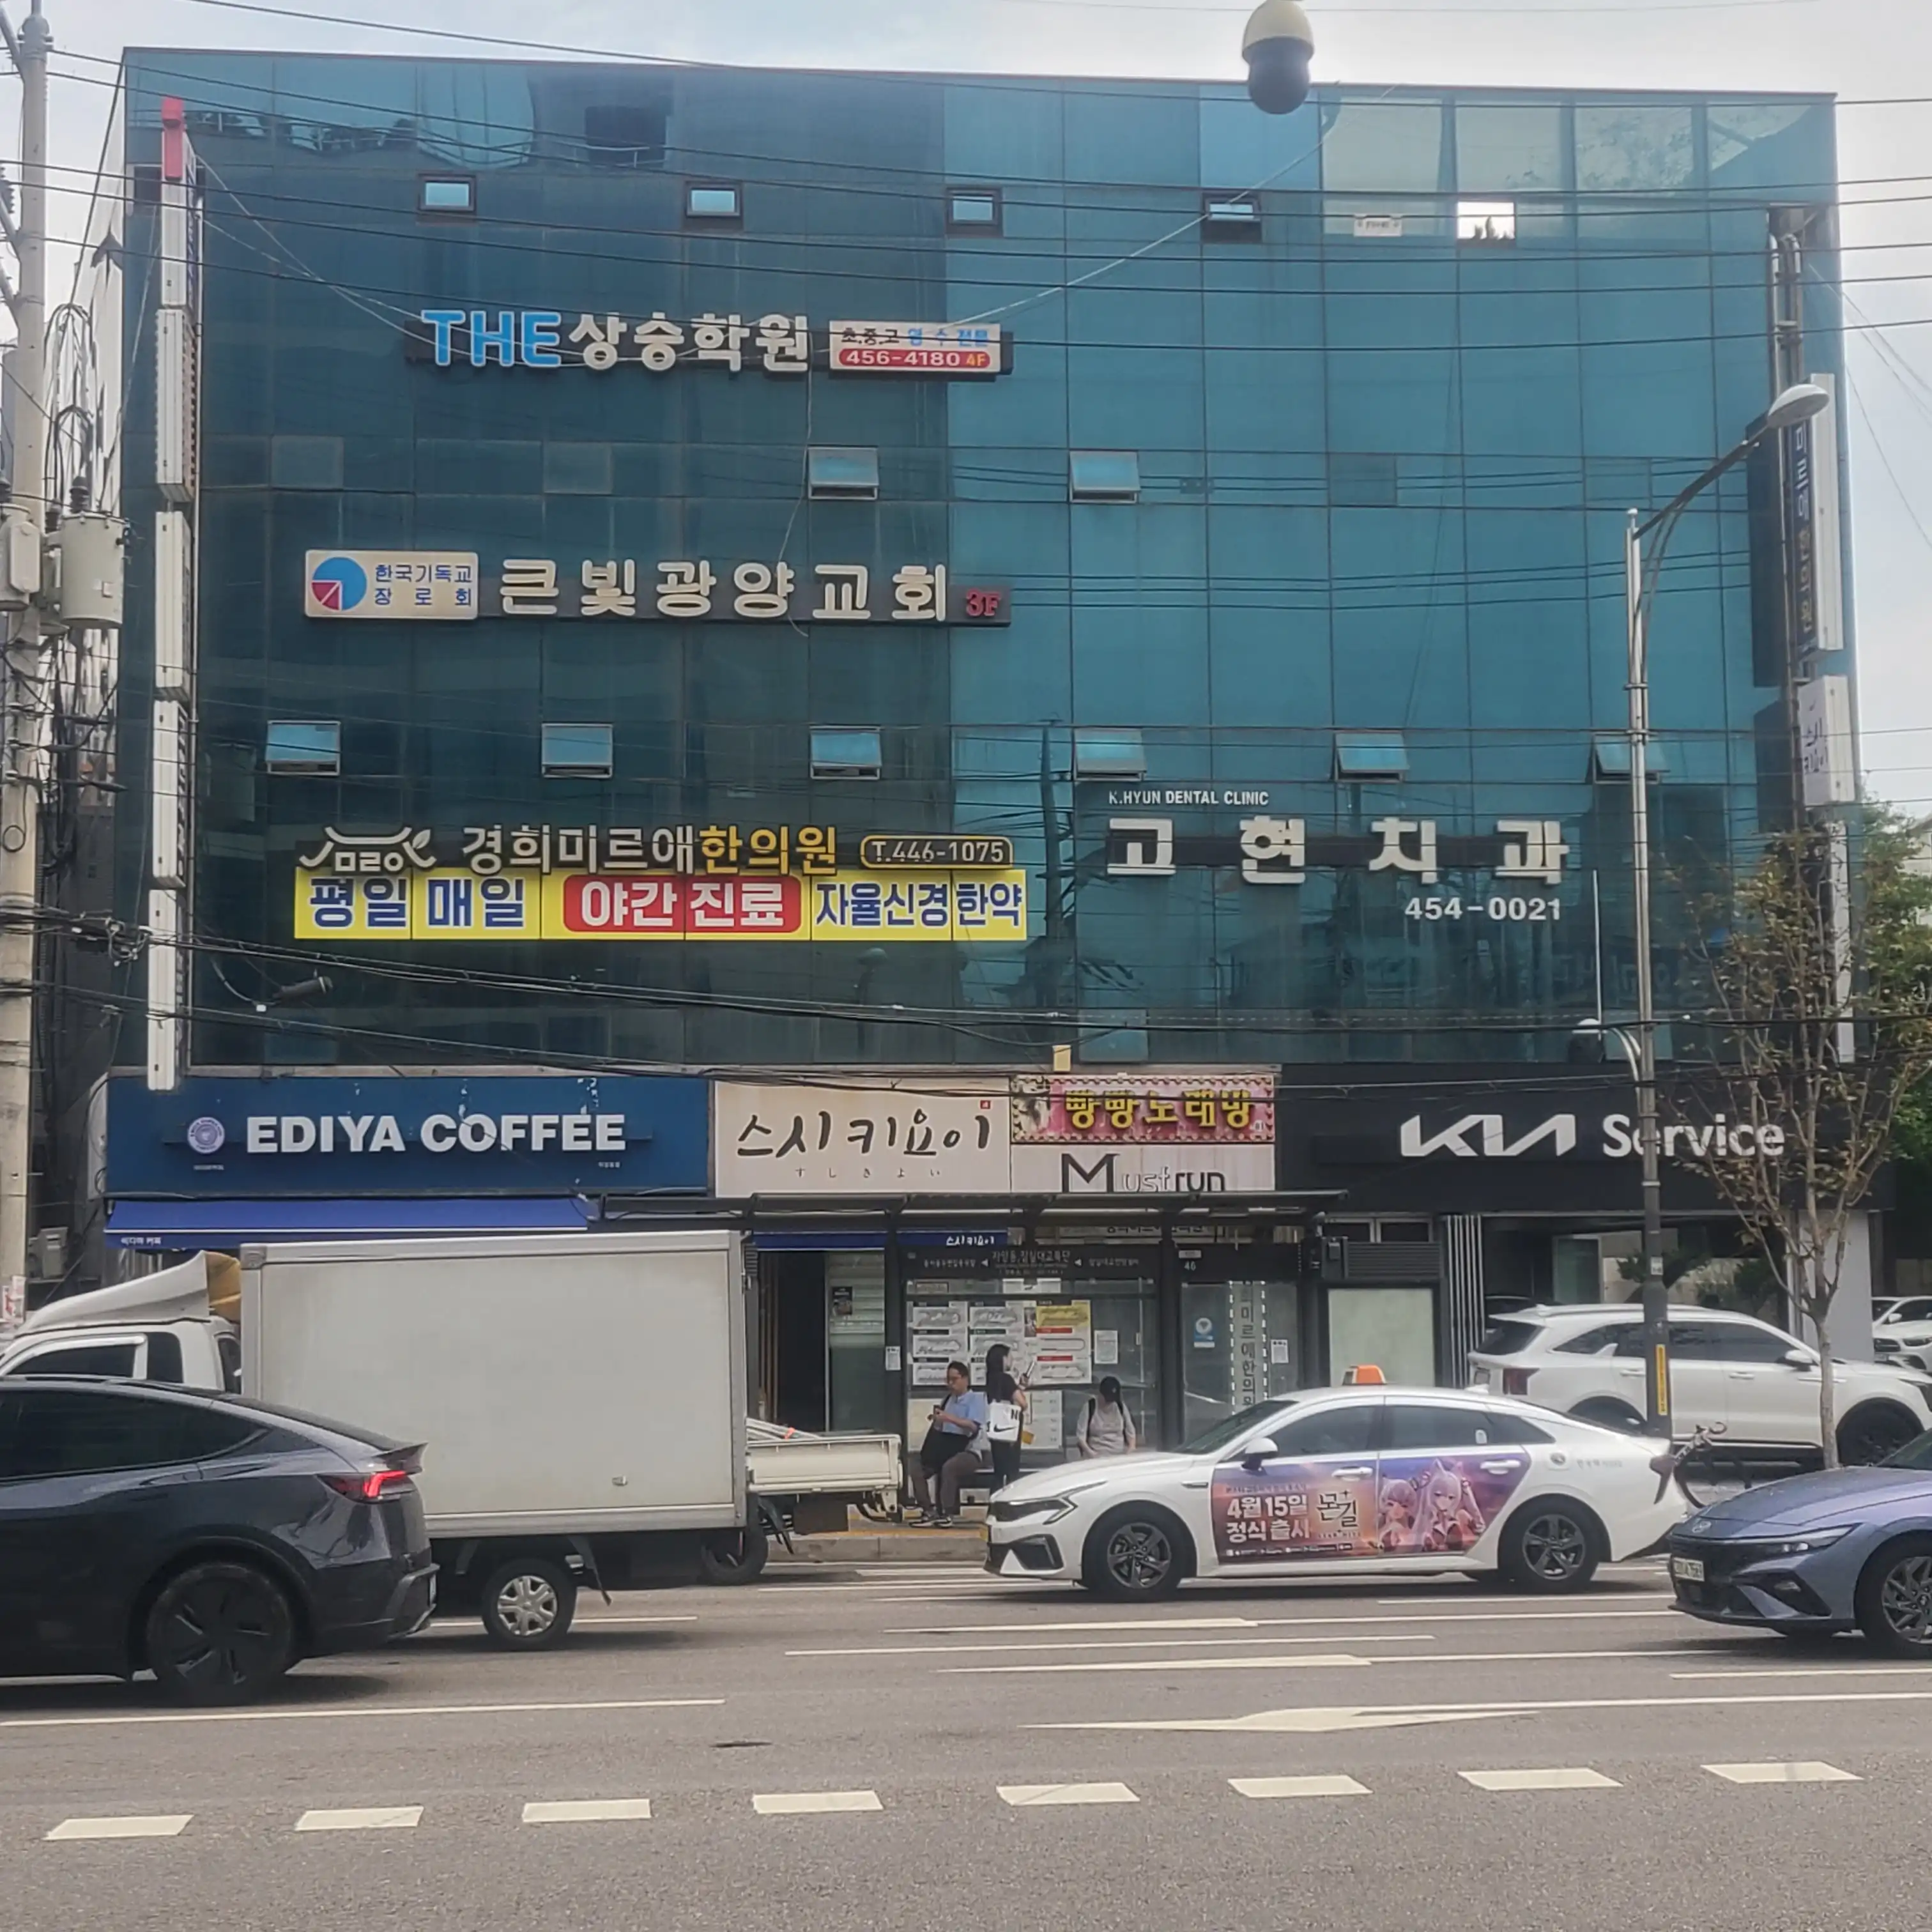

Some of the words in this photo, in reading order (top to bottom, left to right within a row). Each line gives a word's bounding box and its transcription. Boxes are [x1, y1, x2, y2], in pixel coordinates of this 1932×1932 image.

[420, 310, 562, 368] THE
[568, 312, 809, 374] 상승학원
[845, 350, 961, 367] 456-4180
[965, 354, 986, 367] 4F
[374, 564, 473, 584] 한국기독교
[965, 588, 1002, 617] 3F
[1108, 790, 1162, 806] K.HYUN
[1165, 790, 1219, 805] DENTAL
[1223, 790, 1269, 806] CLINIC
[871, 840, 1004, 863] T.446-1075
[309, 877, 408, 930] 평일
[425, 876, 526, 929] 매일
[581, 880, 677, 927] 야간
[689, 881, 785, 928] 진료
[1405, 898, 1561, 921] 454-0021
[247, 1116, 406, 1153] EDIYA
[420, 1113, 626, 1152] COFFEE
[1399, 1114, 1577, 1157] KIA
[1227, 1496, 1262, 1519] 4월
[1264, 1494, 1308, 1517] 15일
[1226, 1520, 1267, 1544] 정식
[1270, 1518, 1310, 1541] 출시
